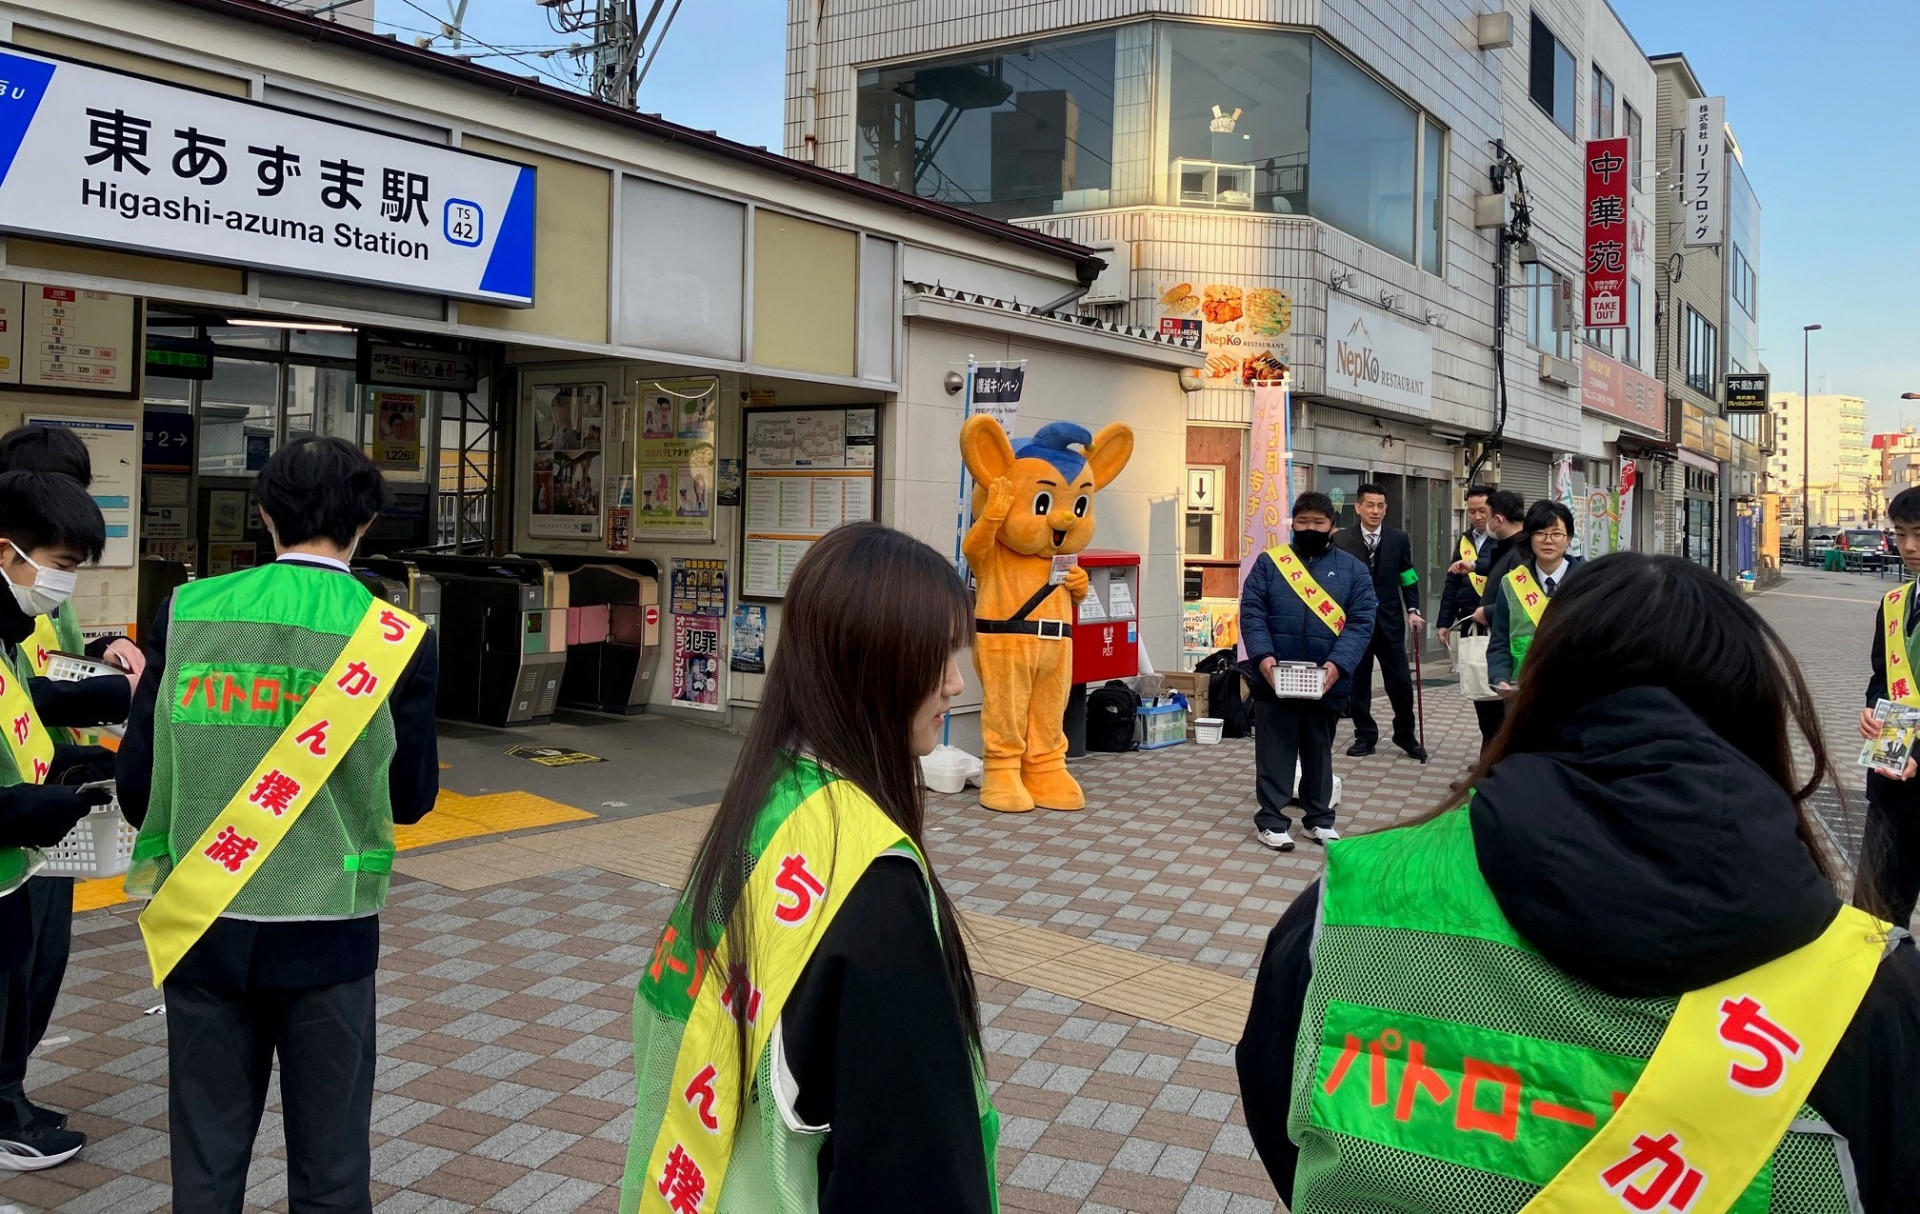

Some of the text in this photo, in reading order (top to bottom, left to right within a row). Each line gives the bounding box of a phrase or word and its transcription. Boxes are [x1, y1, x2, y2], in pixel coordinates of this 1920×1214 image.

[83, 106, 431, 228] 東あずま駅
[1695, 104, 1710, 240] 株式会社 リープフロッグ
[81, 178, 430, 261] Higashi-azuma Station
[457, 207, 471, 220] TS
[1588, 151, 1624, 273] 中華苑
[452, 223, 474, 240] 42
[1593, 301, 1617, 311] TAKE
[1596, 311, 1614, 320] OUT
[1243, 339, 1285, 349] RESTAURANT
[976, 377, 1020, 394] 撲滅キャンペーン
[1381, 370, 1424, 396] RESTAURANT
[1728, 380, 1765, 391] 不動産
[158, 431, 169, 447] 2
[1514, 571, 1539, 607] ちか
[685, 628, 718, 654] 犯罪
[674, 616, 687, 698] オンラインカジノ
[181, 670, 317, 713] パトロー
[204, 609, 412, 874] ちかん撲滅
[1323, 1028, 1635, 1143] パトロー
[1601, 996, 1802, 1213] ちか
